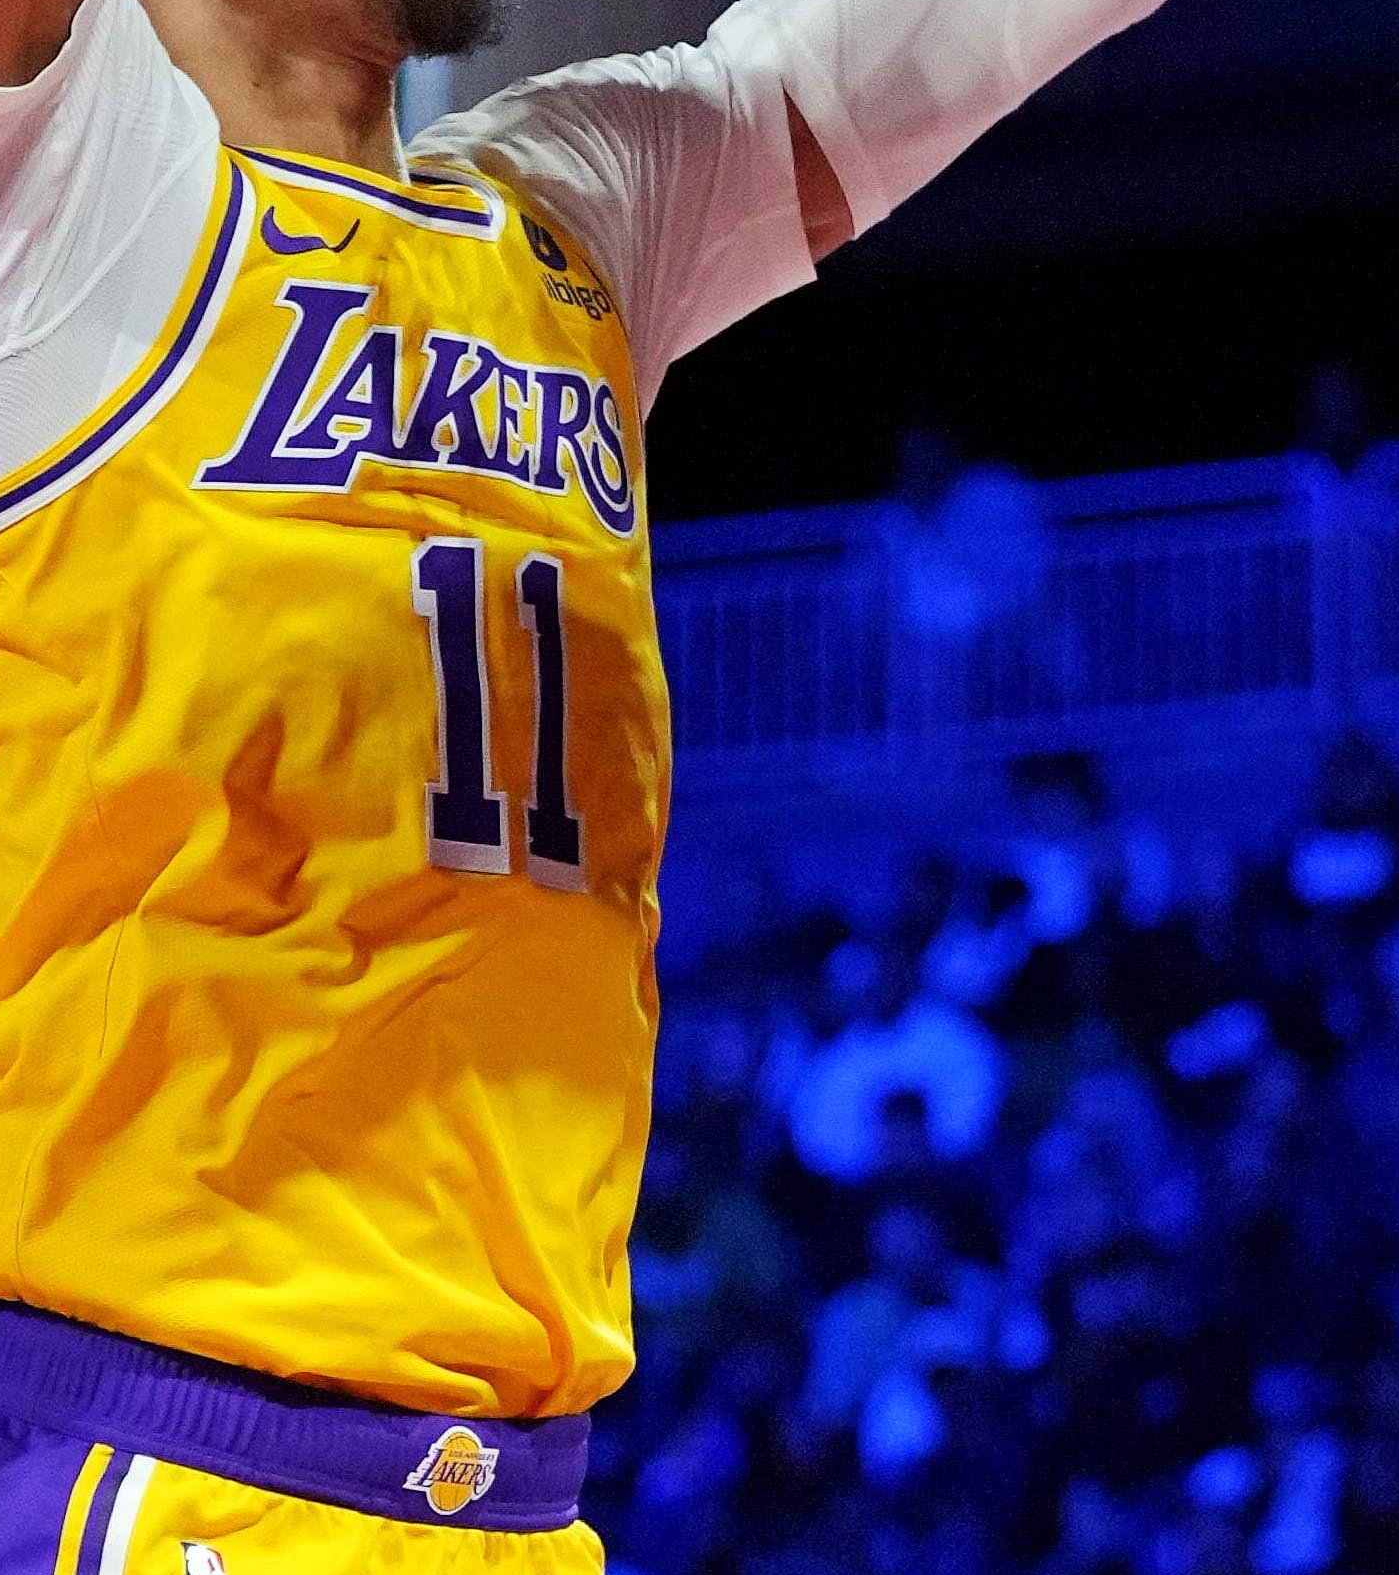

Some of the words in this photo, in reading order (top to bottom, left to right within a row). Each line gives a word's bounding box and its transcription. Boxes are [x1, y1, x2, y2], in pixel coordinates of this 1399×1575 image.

[192, 278, 635, 538] LAKERS
[410, 537, 588, 893] 11
[409, 1447, 492, 1495] LAKERS
